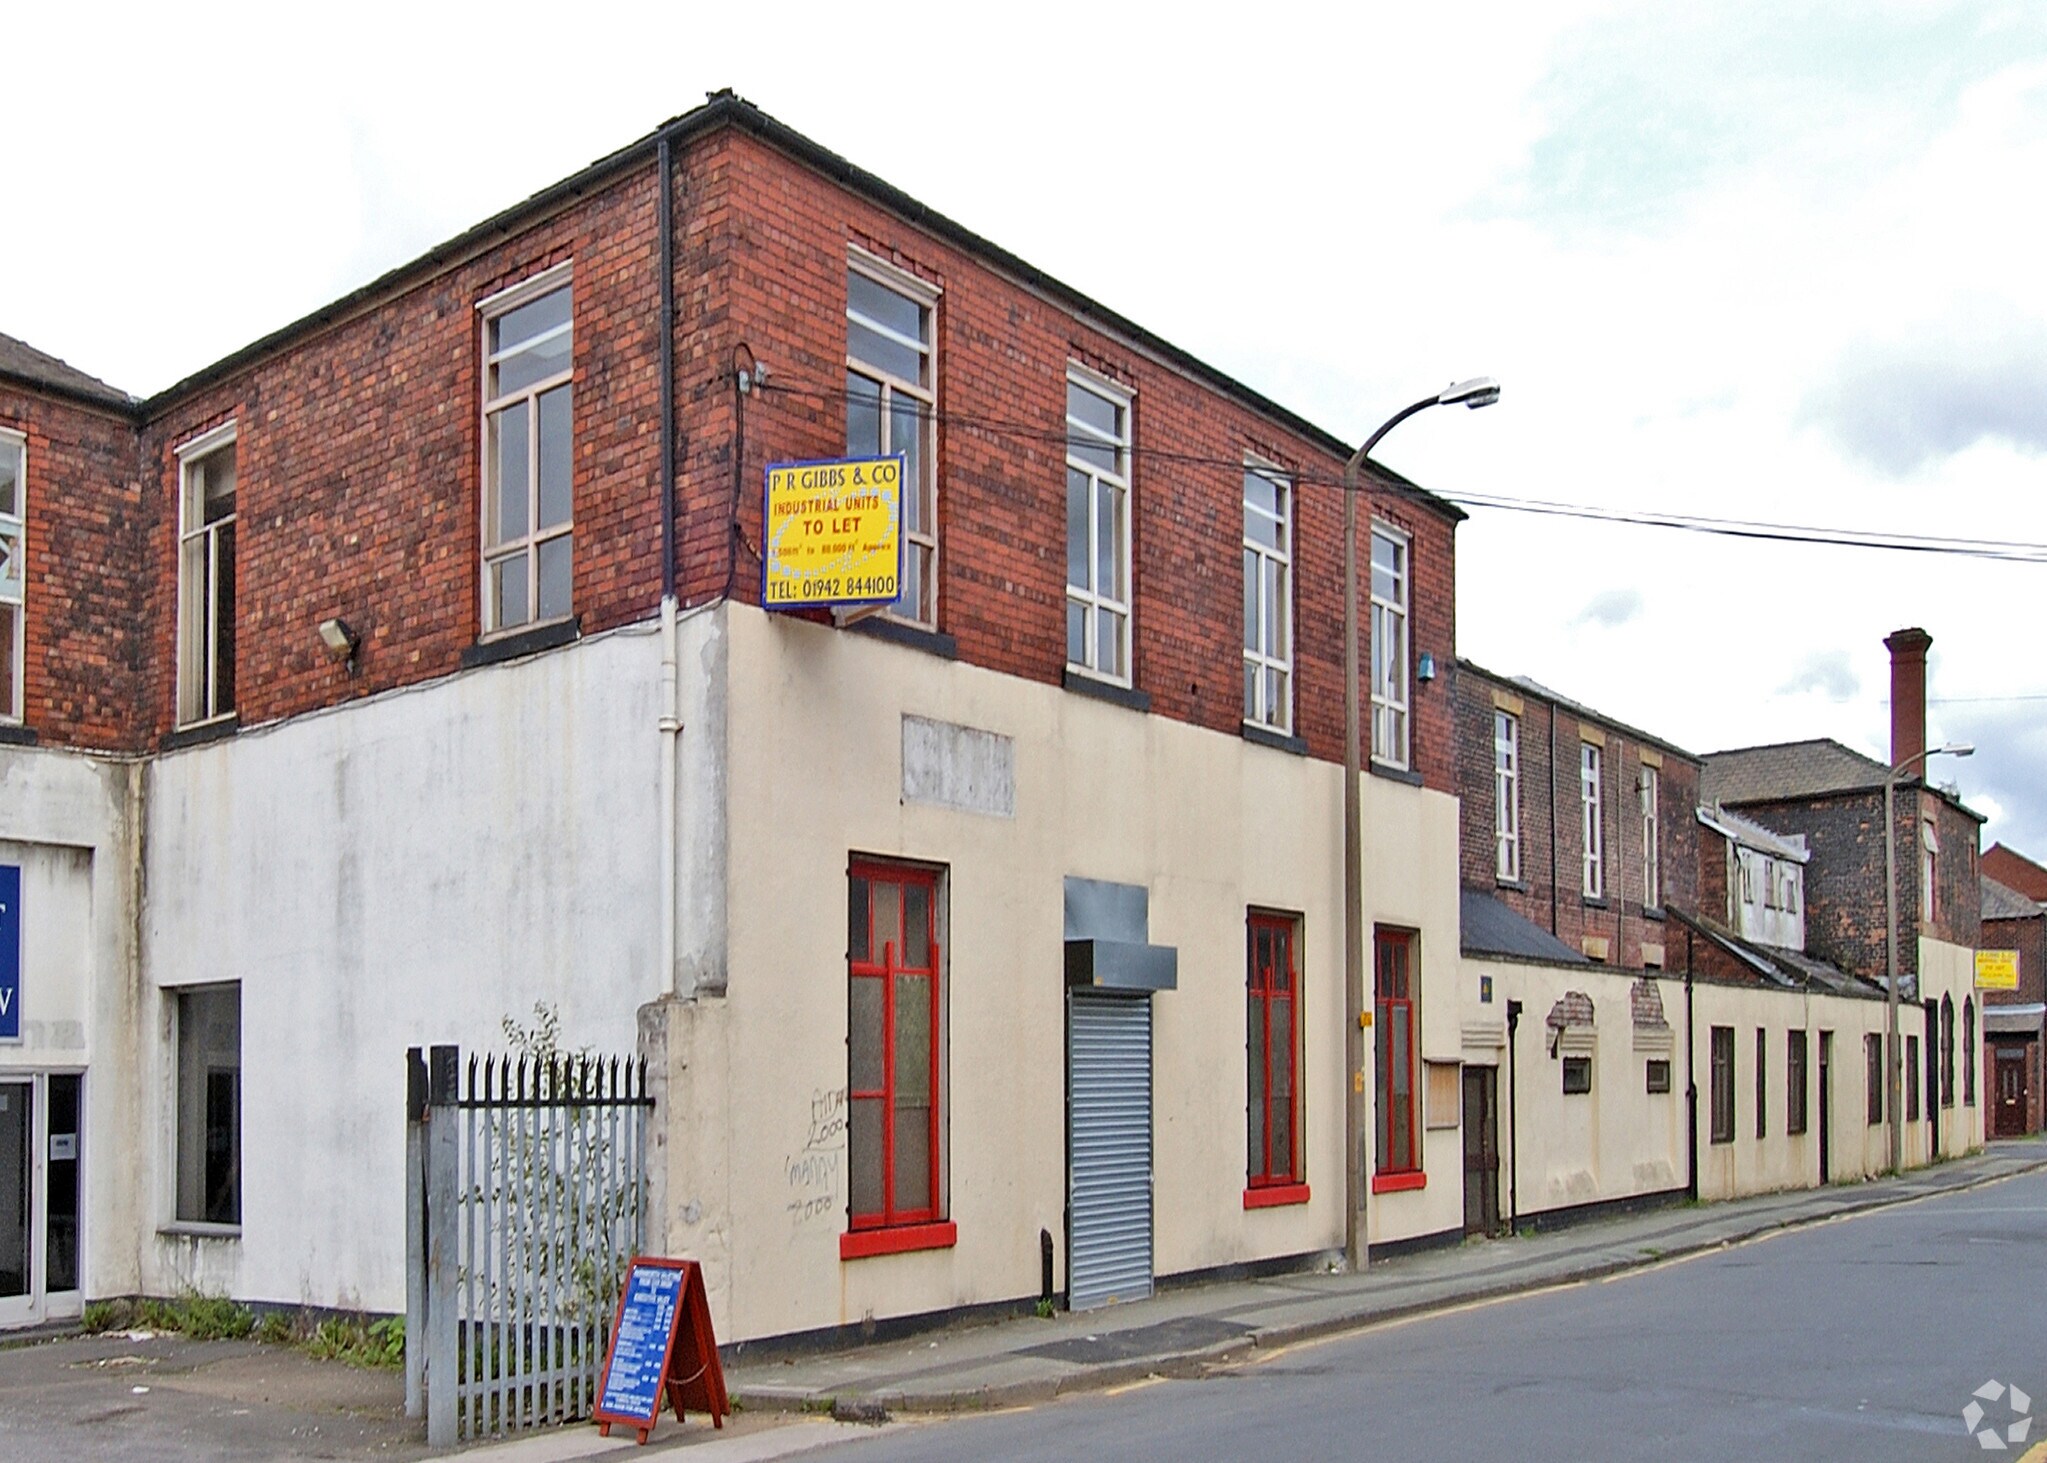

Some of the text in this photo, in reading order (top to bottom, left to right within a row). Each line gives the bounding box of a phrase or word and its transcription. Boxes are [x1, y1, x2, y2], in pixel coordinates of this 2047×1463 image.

[772, 464, 896, 492] P R GIBBS & CO
[774, 495, 879, 516] INDUSTRIAL UNITS
[803, 517, 862, 536] TO LET
[770, 575, 895, 599] TEL: 01942 844100
